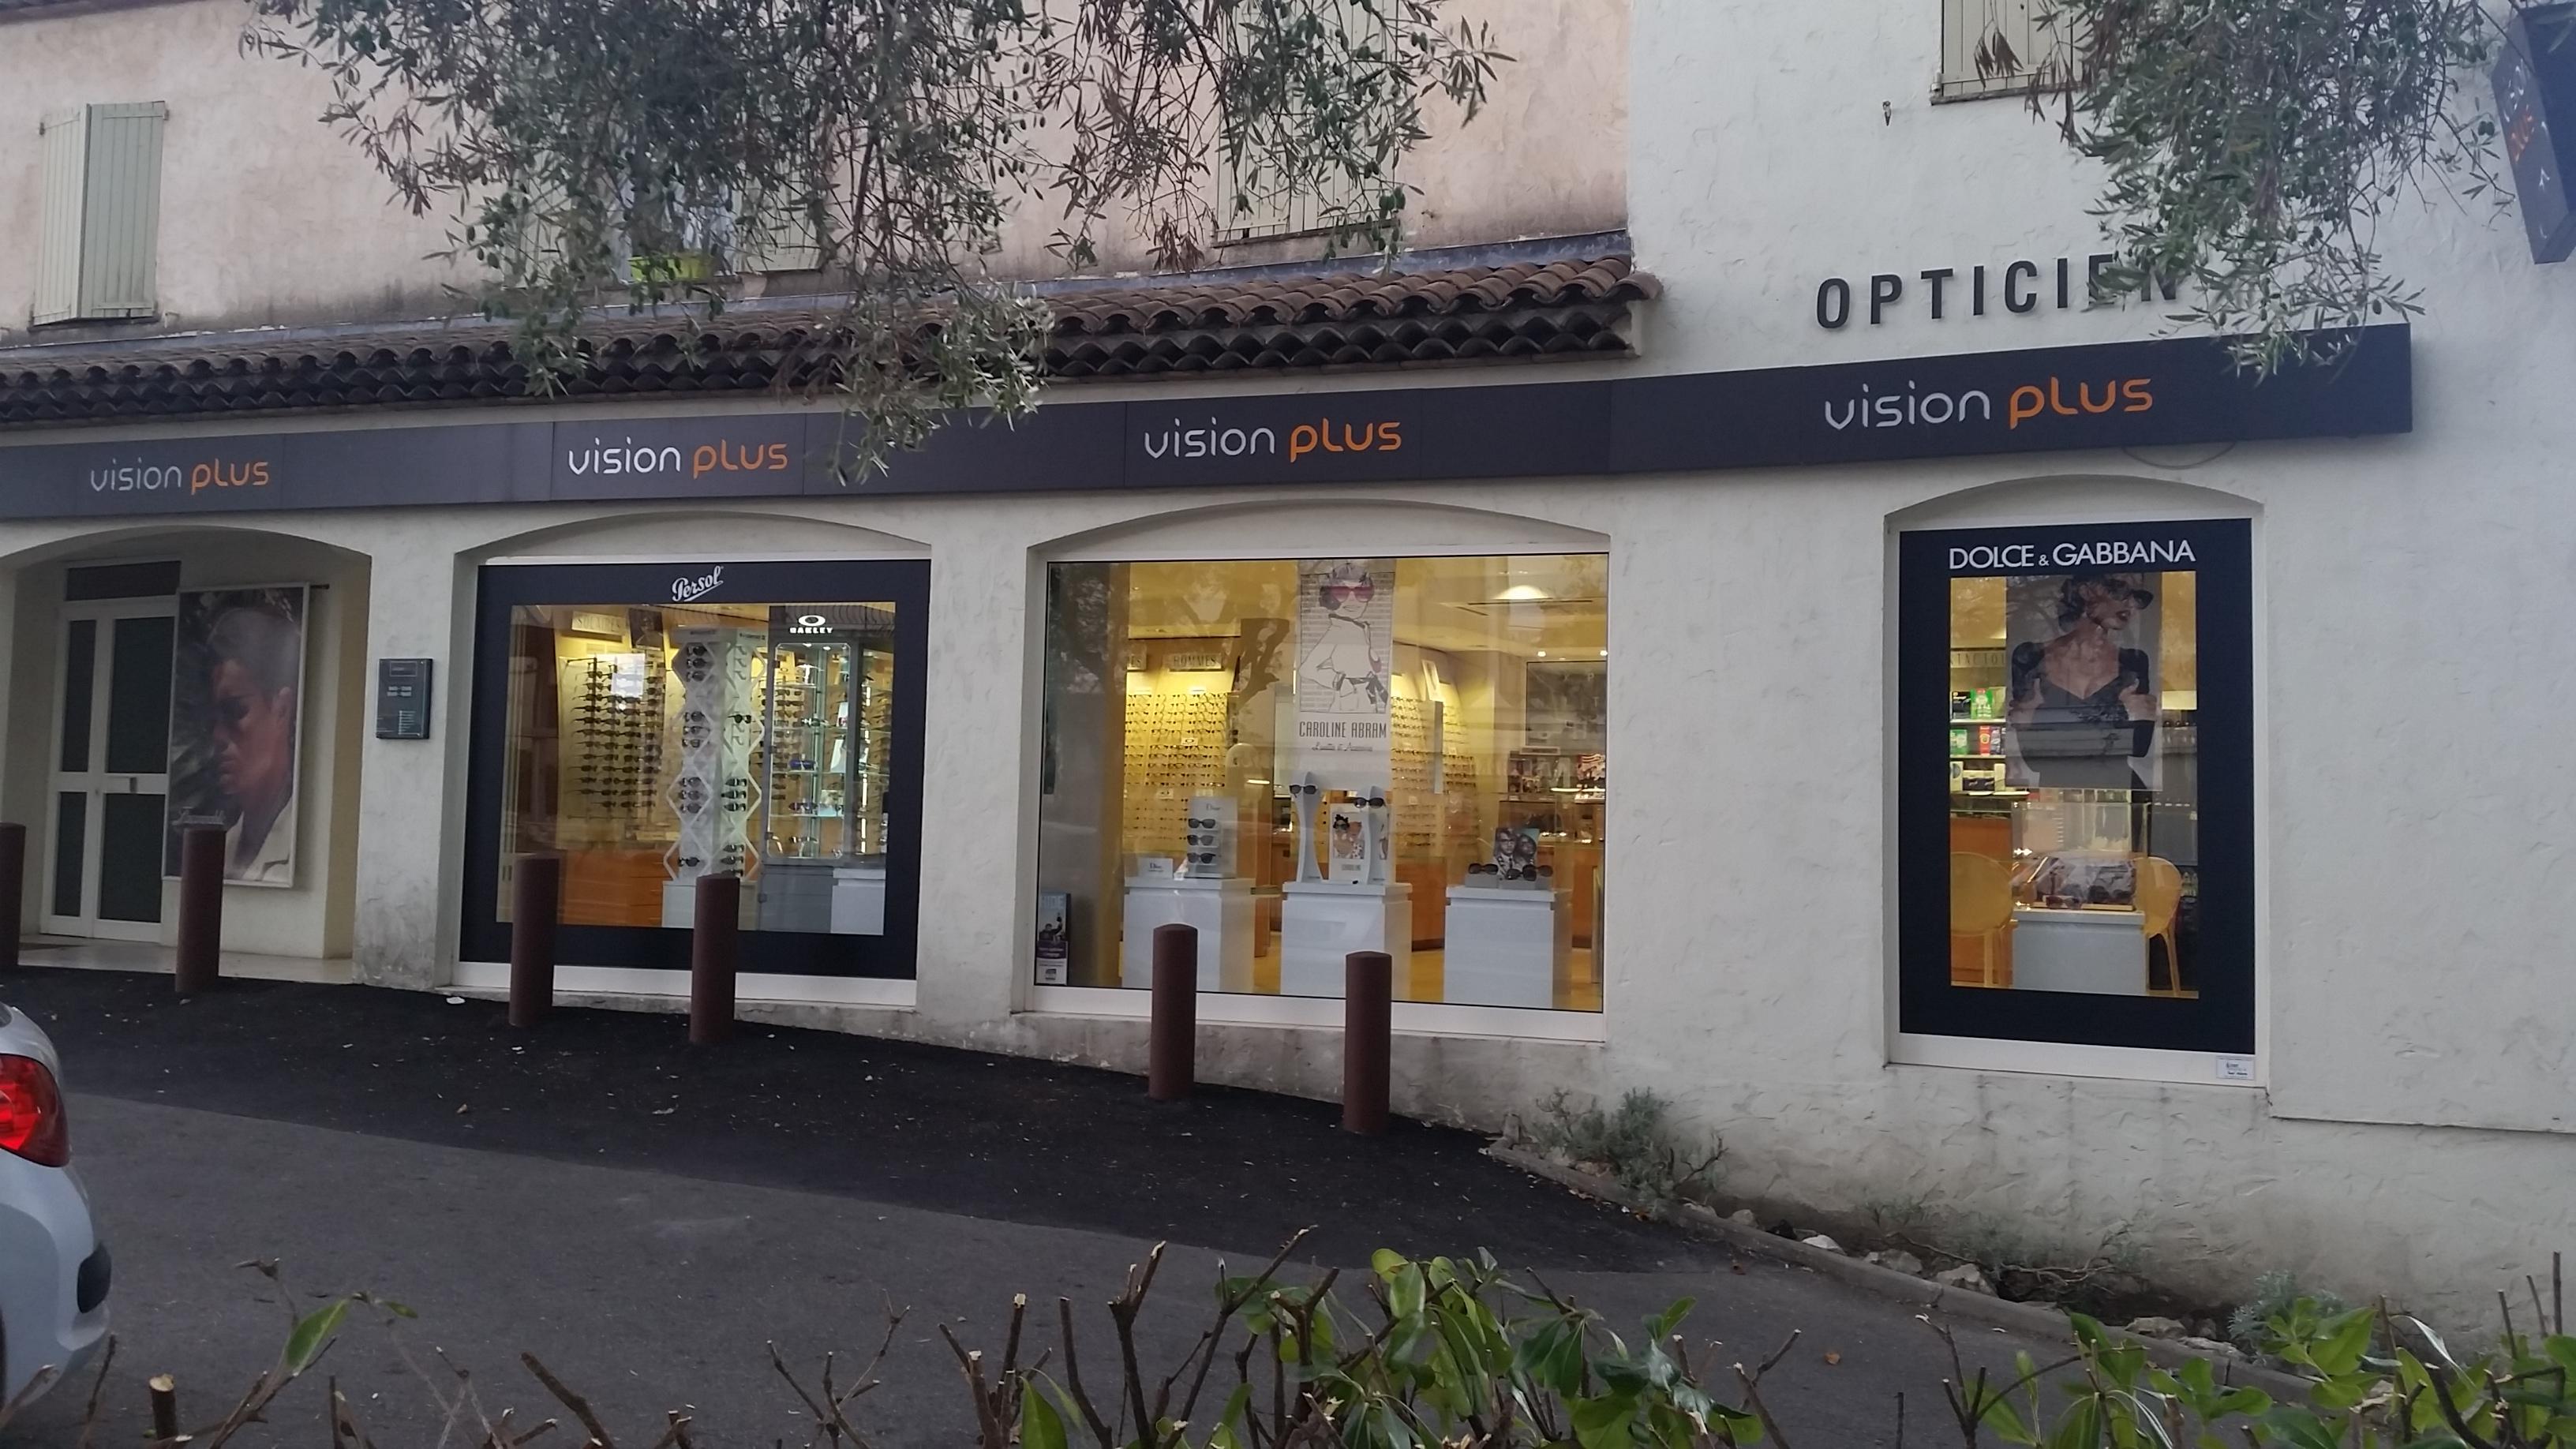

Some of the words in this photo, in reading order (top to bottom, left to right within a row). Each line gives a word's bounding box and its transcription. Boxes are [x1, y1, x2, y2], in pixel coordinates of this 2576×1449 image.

[1825, 380, 1990, 430] vision
[2009, 376, 2154, 430] plus
[568, 436, 682, 475] vision
[692, 438, 788, 479] plus
[1144, 416, 1275, 459] vision
[1290, 417, 1402, 463] plus
[90, 456, 182, 492] vision
[190, 458, 270, 496] plus
[1949, 545, 2035, 570] DOLCE
[2038, 554, 2050, 567] &
[2052, 540, 2196, 567] GABBANA
[672, 565, 724, 602] Persol
[1299, 721, 1346, 738] CAROLINE
[1351, 721, 1387, 739] ABRAM
